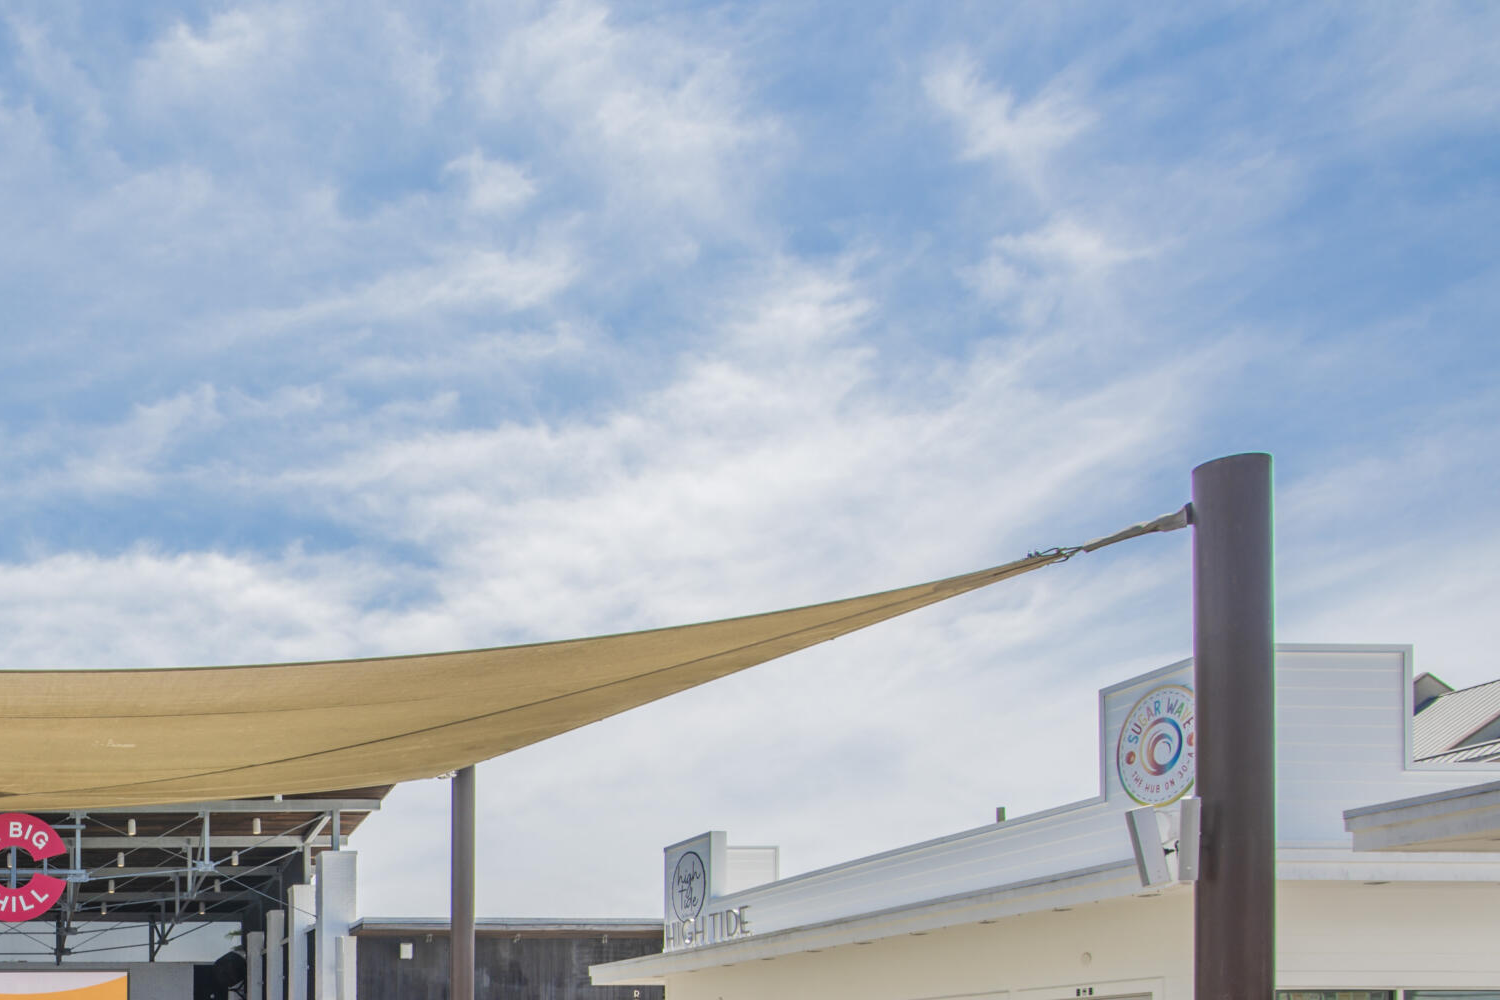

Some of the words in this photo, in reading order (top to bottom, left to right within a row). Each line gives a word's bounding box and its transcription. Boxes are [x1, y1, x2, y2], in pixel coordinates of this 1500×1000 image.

[1127, 700, 1161, 745] SUGAR
[9, 821, 49, 850] BIG
[665, 915, 705, 950] HIGH
[708, 904, 751, 943] TIDE
